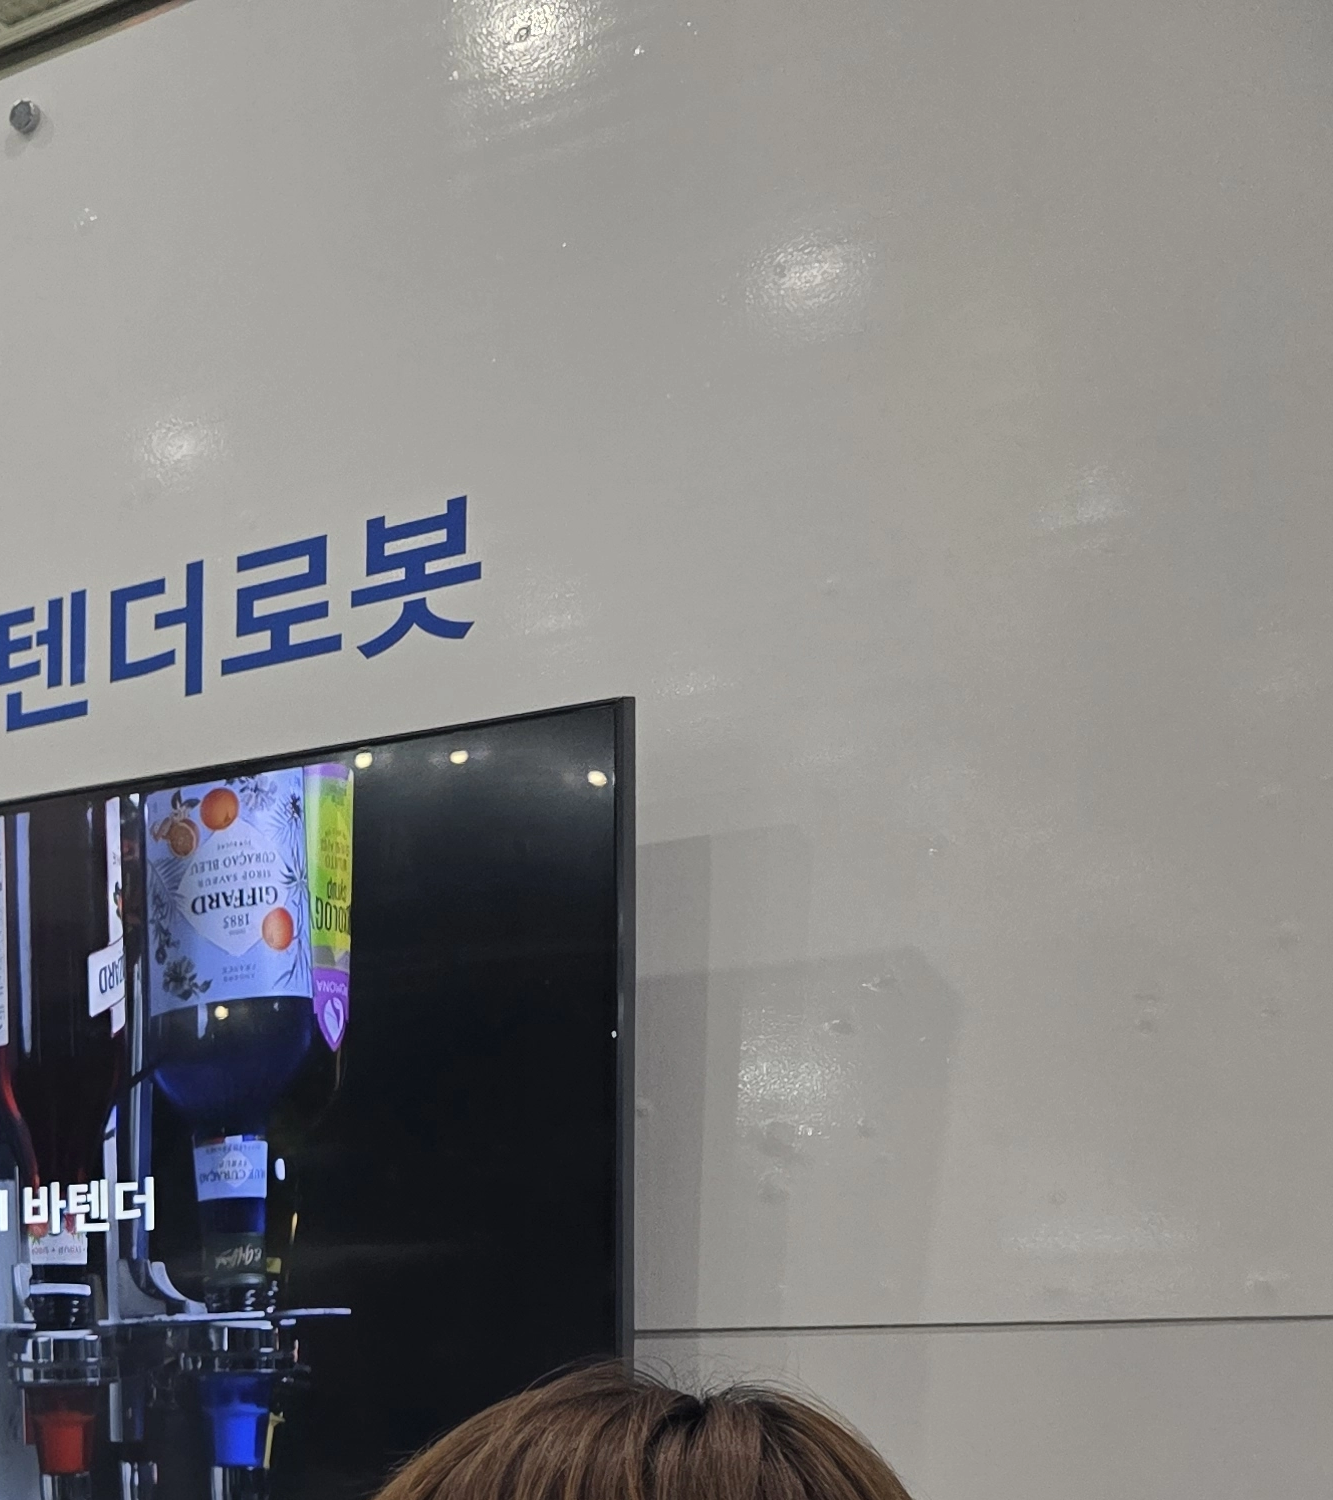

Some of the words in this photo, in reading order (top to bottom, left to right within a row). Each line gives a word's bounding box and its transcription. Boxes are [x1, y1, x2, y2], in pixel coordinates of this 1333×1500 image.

[190, 859, 219, 876] BLEU
[191, 886, 279, 915] GIFFARD
[223, 913, 250, 930] 1885
[23, 1176, 156, 1234] 바텐더
